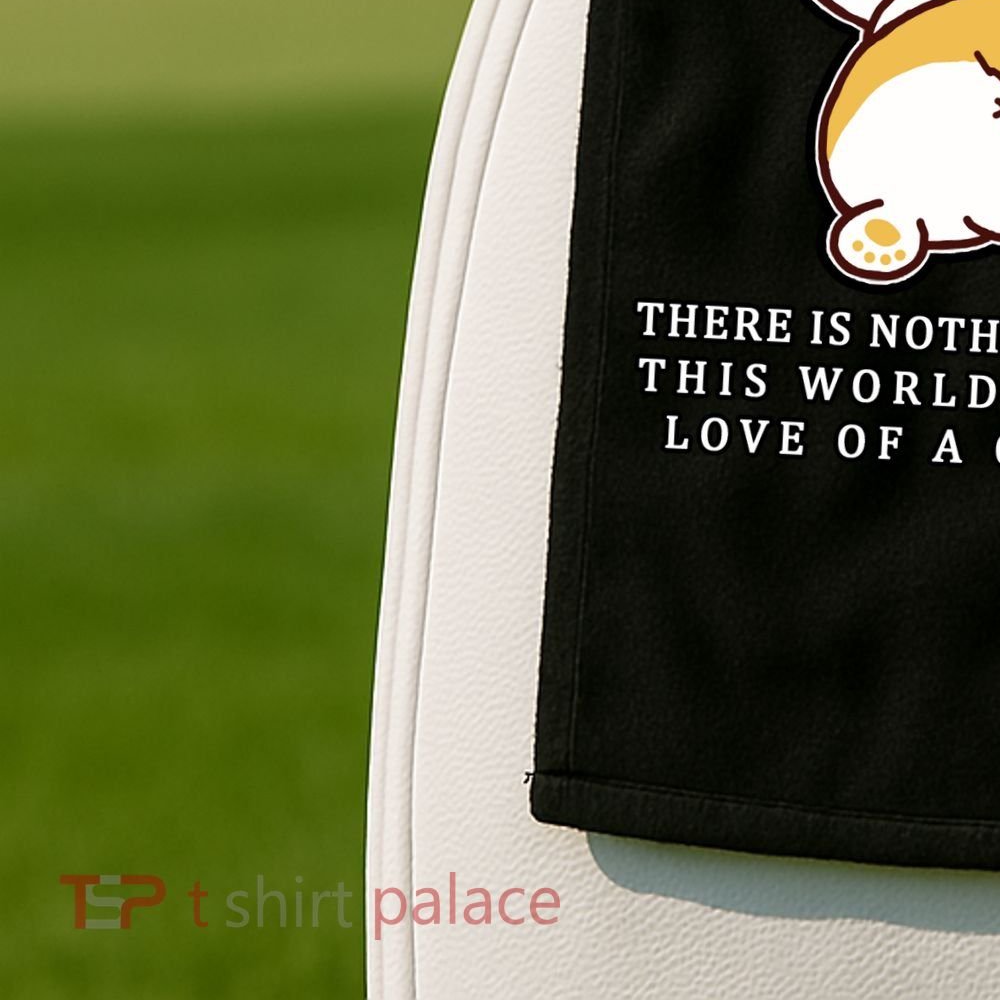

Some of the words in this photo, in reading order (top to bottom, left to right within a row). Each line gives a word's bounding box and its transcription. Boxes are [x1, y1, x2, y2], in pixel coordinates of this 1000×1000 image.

[636, 301, 792, 343] THERE
[810, 310, 851, 346] IS
[638, 357, 767, 398] THIS
[798, 365, 997, 409] WORLD
[664, 414, 805, 456] LOVE
[837, 423, 903, 460] OF
[931, 428, 963, 464] A
